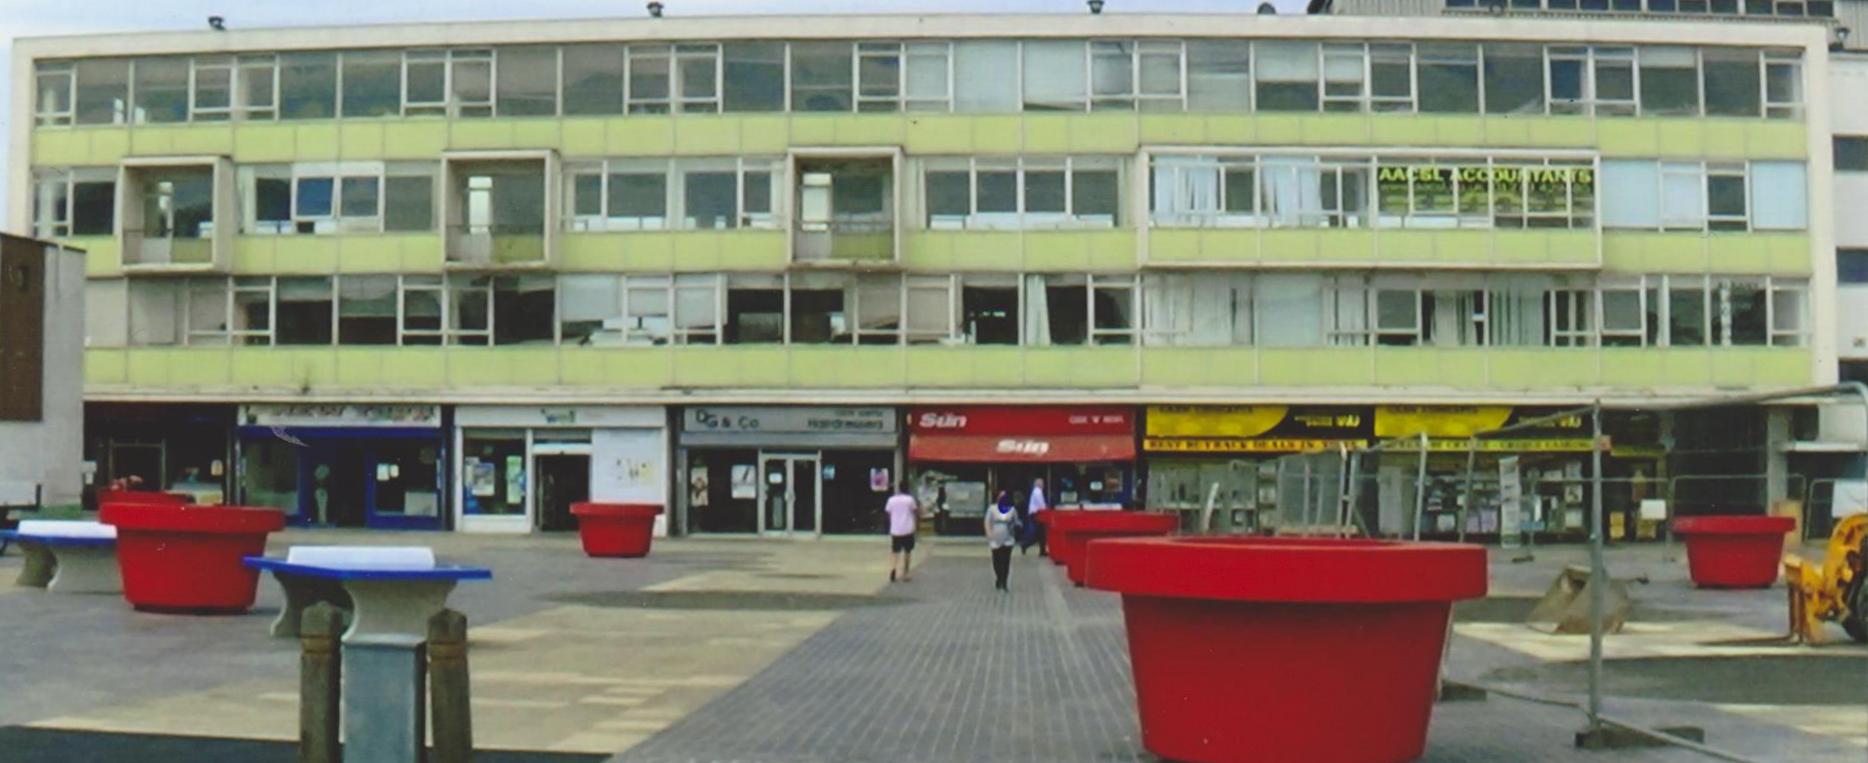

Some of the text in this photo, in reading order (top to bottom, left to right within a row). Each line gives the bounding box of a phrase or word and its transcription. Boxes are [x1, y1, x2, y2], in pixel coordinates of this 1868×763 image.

[1379, 167, 1443, 181] AACSL
[721, 416, 732, 429] &
[738, 416, 759, 429] Co
